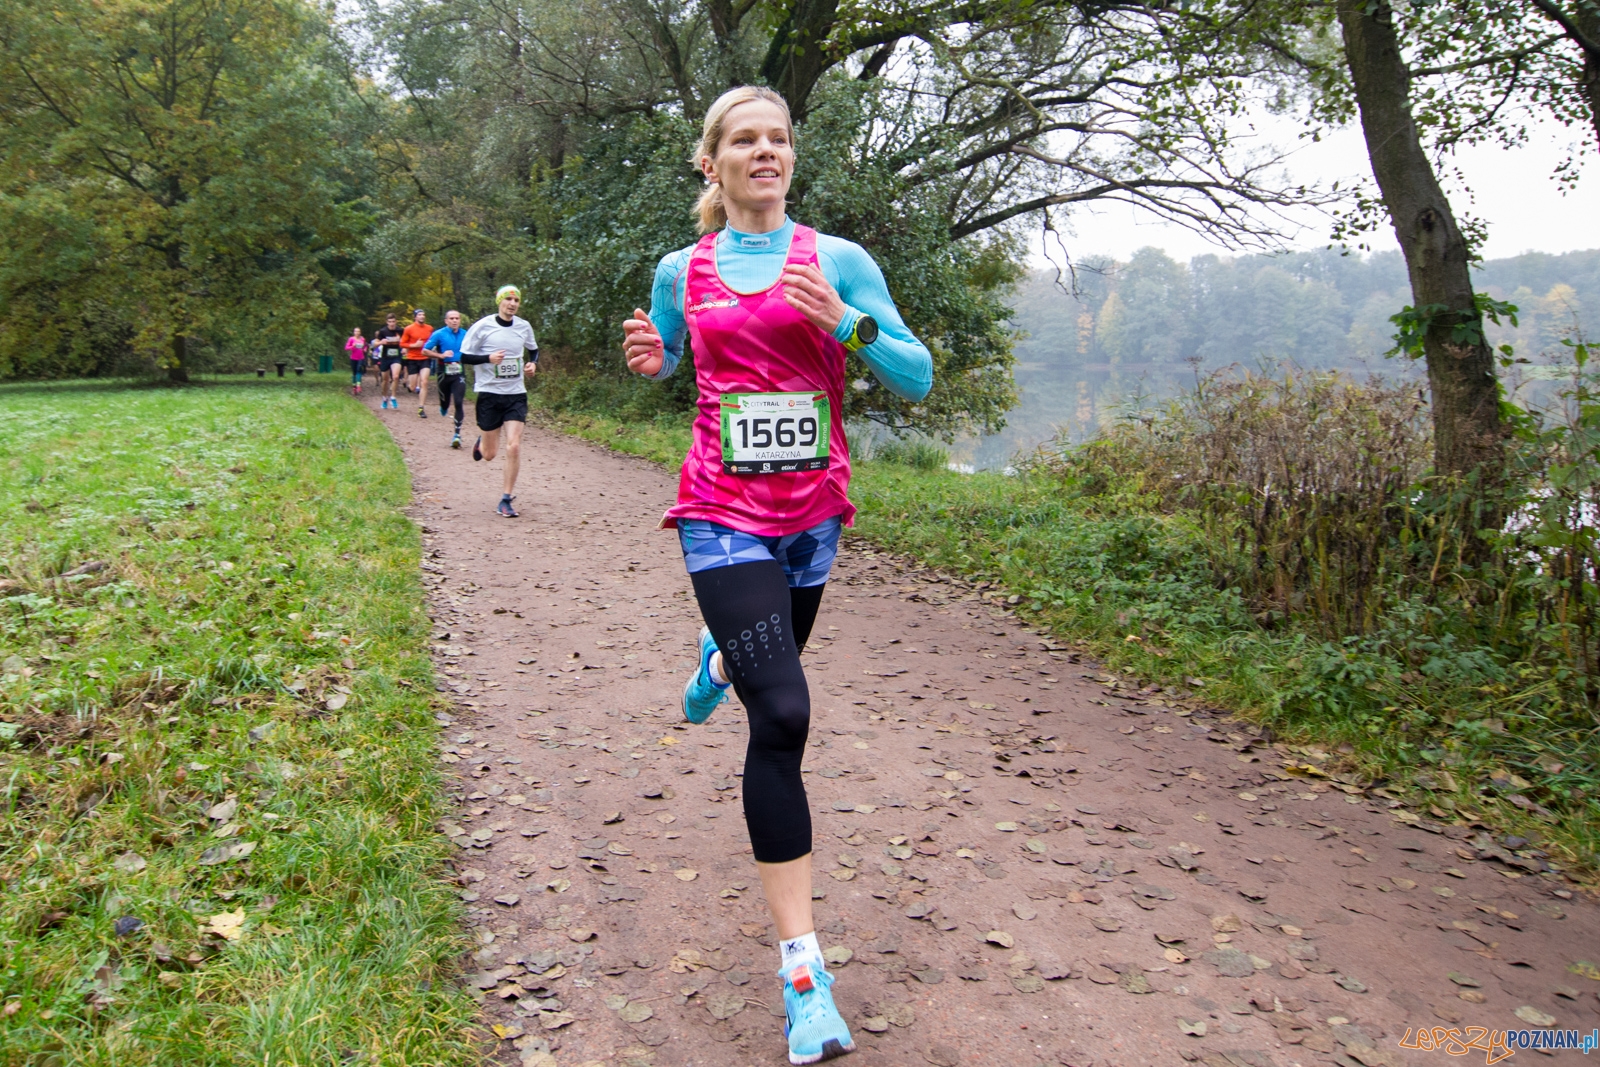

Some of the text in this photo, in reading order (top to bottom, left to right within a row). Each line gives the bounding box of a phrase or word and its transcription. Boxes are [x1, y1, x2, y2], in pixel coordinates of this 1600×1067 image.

[501, 364, 517, 373] 990
[737, 417, 817, 448] 1569
[755, 451, 801, 459] KATARZYNA
